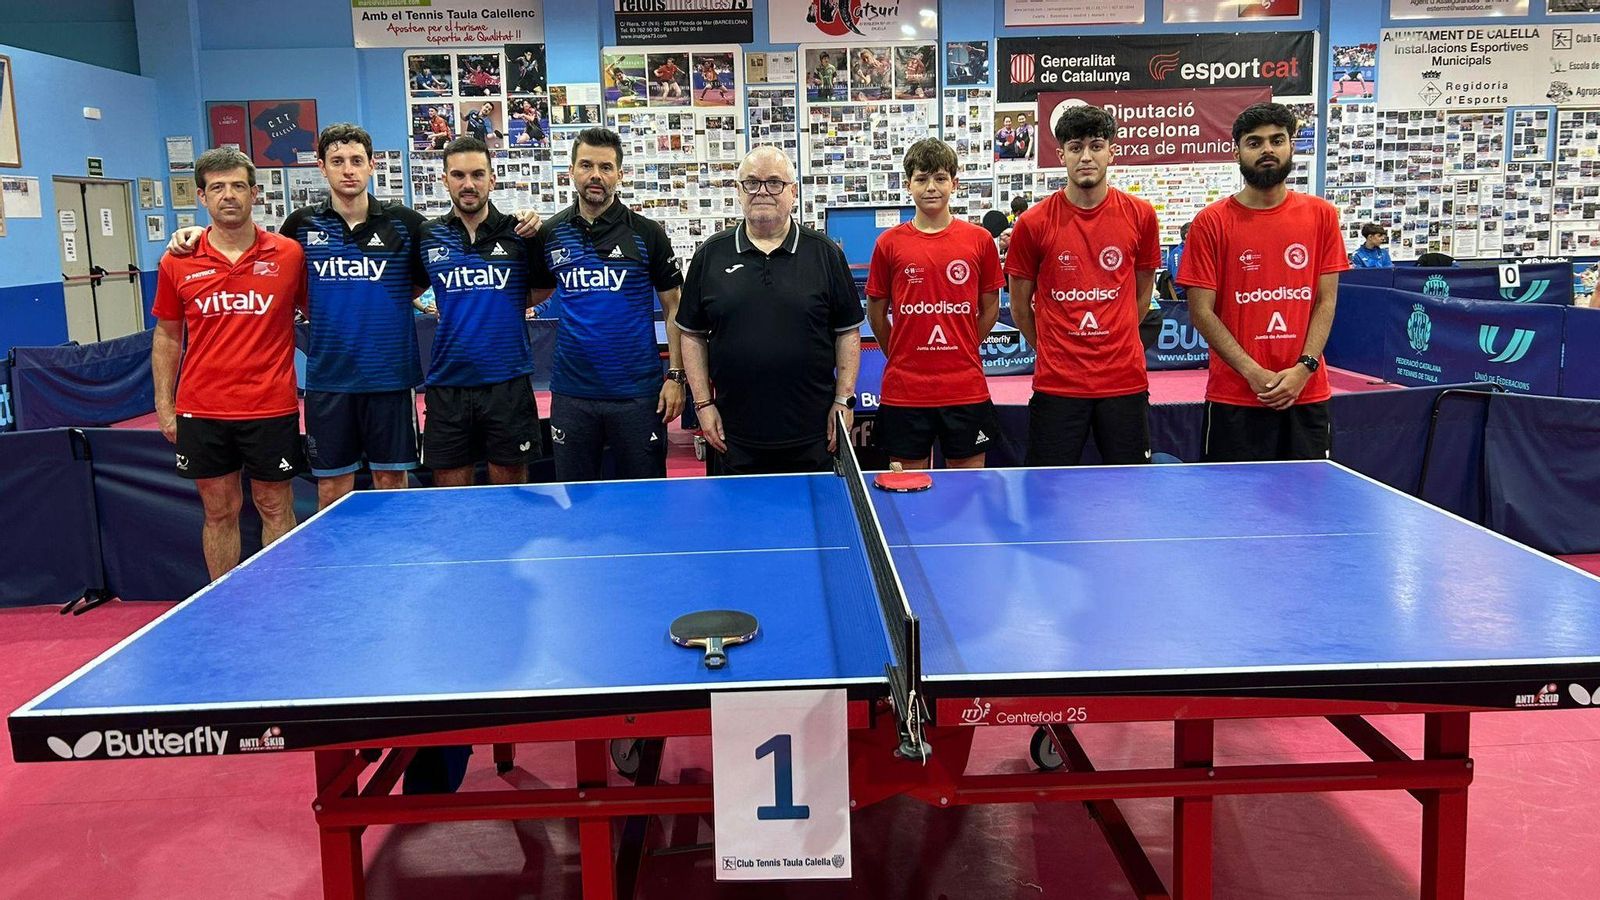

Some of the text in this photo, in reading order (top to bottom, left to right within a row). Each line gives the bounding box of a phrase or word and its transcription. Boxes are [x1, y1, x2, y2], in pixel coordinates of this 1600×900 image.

[362, 8, 535, 21] Amb el Tennis Taula Calellenc
[387, 20, 488, 36] Apostem per el turisme
[1467, 30, 1484, 40] DE
[1487, 28, 1540, 40] CALELLA
[427, 31, 462, 45] esportiu
[463, 32, 475, 41] de
[477, 28, 514, 42] Qualitat
[1576, 34, 1592, 43] Club
[1394, 41, 1528, 55] Instal.lacions Esportives
[1040, 54, 1115, 68] Generalitat
[1431, 55, 1491, 67] Municipals
[1569, 61, 1590, 70] Escola
[1040, 69, 1130, 85] de Catalunya
[1180, 55, 1299, 84] esportcat
[1446, 81, 1508, 92] Regidoria
[1445, 94, 1508, 105] d'Esports
[1103, 102, 1195, 122] Diputació
[1116, 123, 1200, 138] arcelona
[1114, 143, 1149, 156] arxa
[1155, 141, 1175, 155] de
[313, 256, 387, 281] vitaly
[1505, 267, 1517, 284] 0
[438, 265, 510, 289] vitaly
[559, 266, 627, 291] vitaly
[195, 289, 274, 315] vitaly
[982, 335, 1011, 344] utterfly
[1396, 367, 1403, 375] DE
[1418, 372, 1424, 380] DE
[1424, 373, 1438, 383] TAULA
[1515, 694, 1559, 704] ANTI SKID
[996, 711, 1062, 724] Centrefold
[1067, 707, 1087, 722] 25
[104, 727, 229, 757] Butterfly
[240, 737, 285, 748] ANTI SKID
[755, 734, 810, 820] 1
[736, 857, 831, 868] Club Tennis Taula Calella
